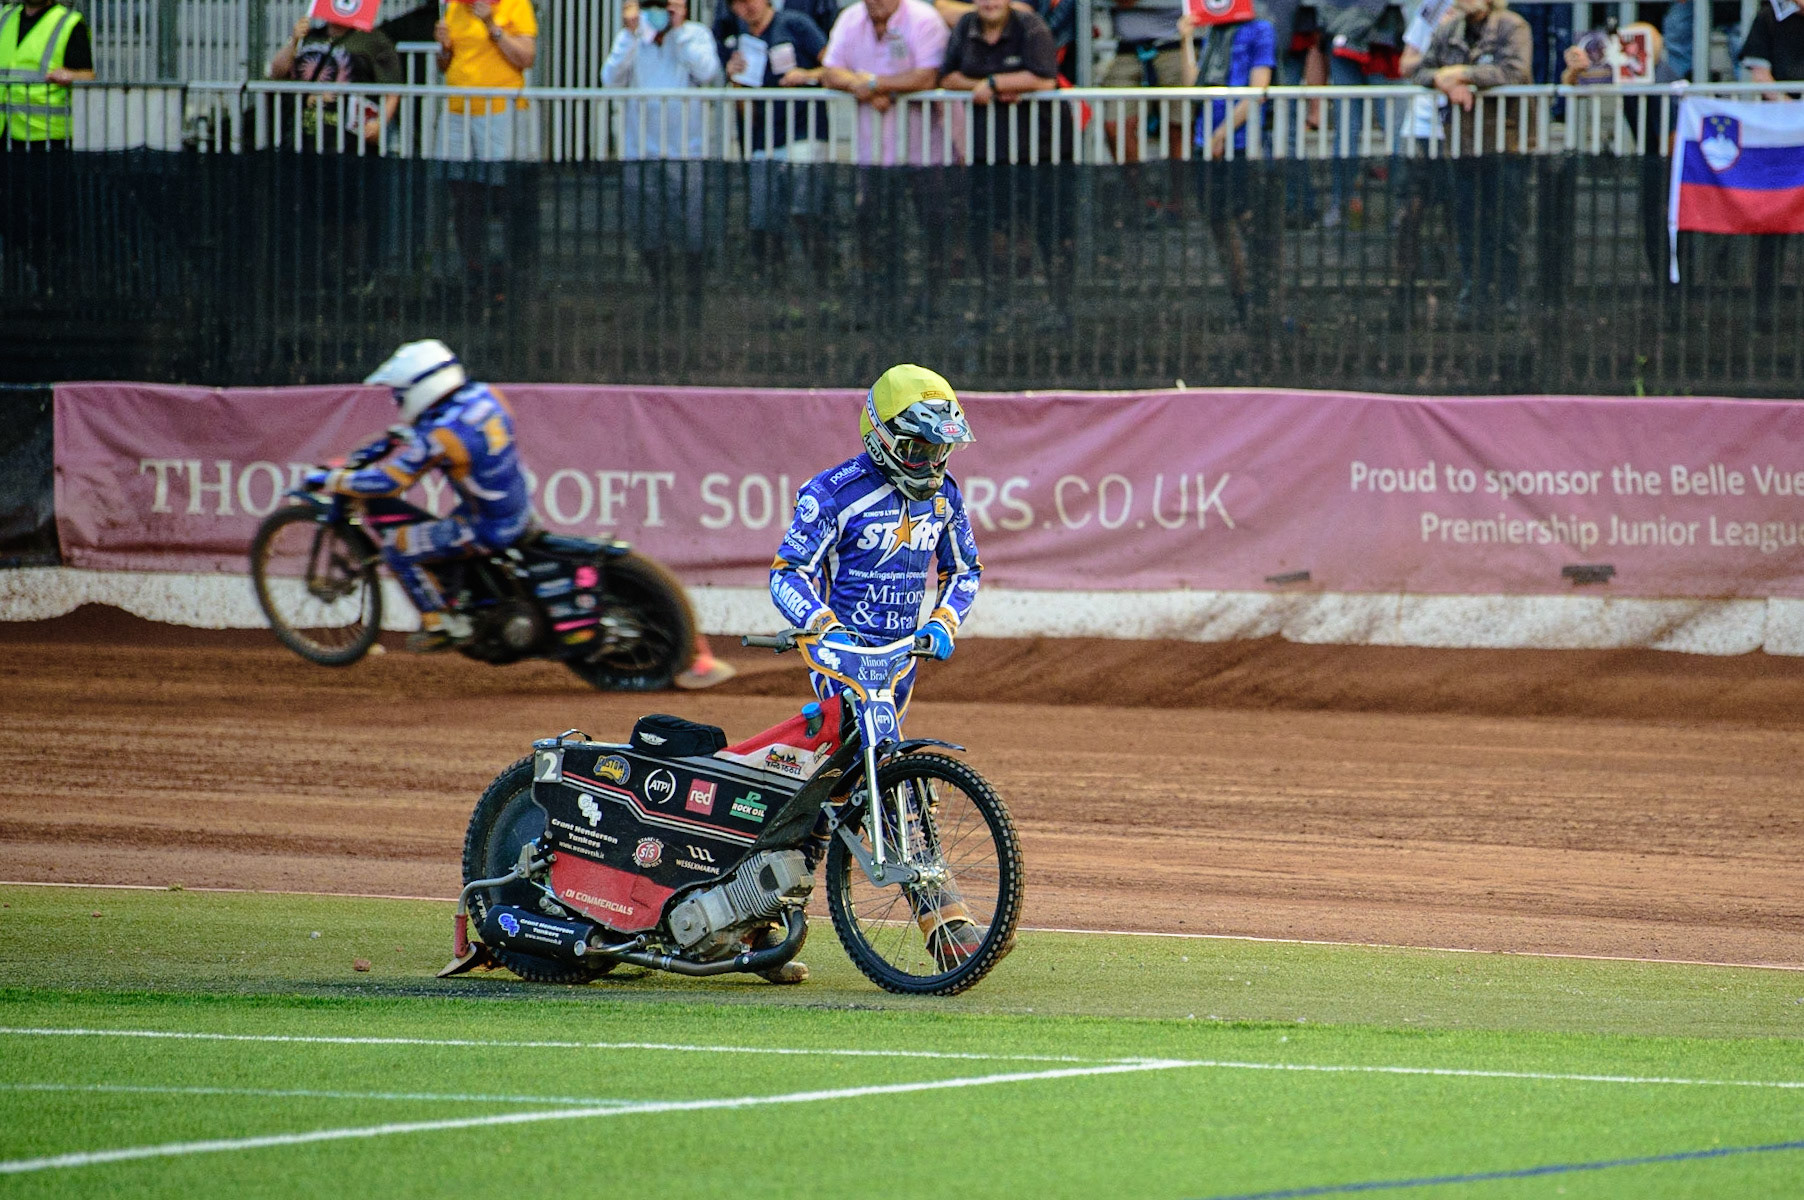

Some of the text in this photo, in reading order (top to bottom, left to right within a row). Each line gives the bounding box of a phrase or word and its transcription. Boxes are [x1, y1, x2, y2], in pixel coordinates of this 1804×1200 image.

[1350, 461, 1804, 500] Proud to sponsor the Belle Vue
[140, 458, 1236, 532] THOYOFT SOLRS.CO.UK
[935, 496, 946, 515] 2
[1421, 512, 1804, 554] Premiership Junior Leagu
[851, 600, 880, 628] &
[857, 667, 867, 680] &
[861, 656, 888, 667] Minors
[541, 752, 558, 780] 2
[648, 779, 671, 794] ATPI
[689, 782, 715, 806] red
[731, 802, 765, 818] ROCK OIL
[551, 818, 575, 830] Grant
[575, 821, 618, 844] Henderson
[575, 891, 634, 916] COMMERCIALS
